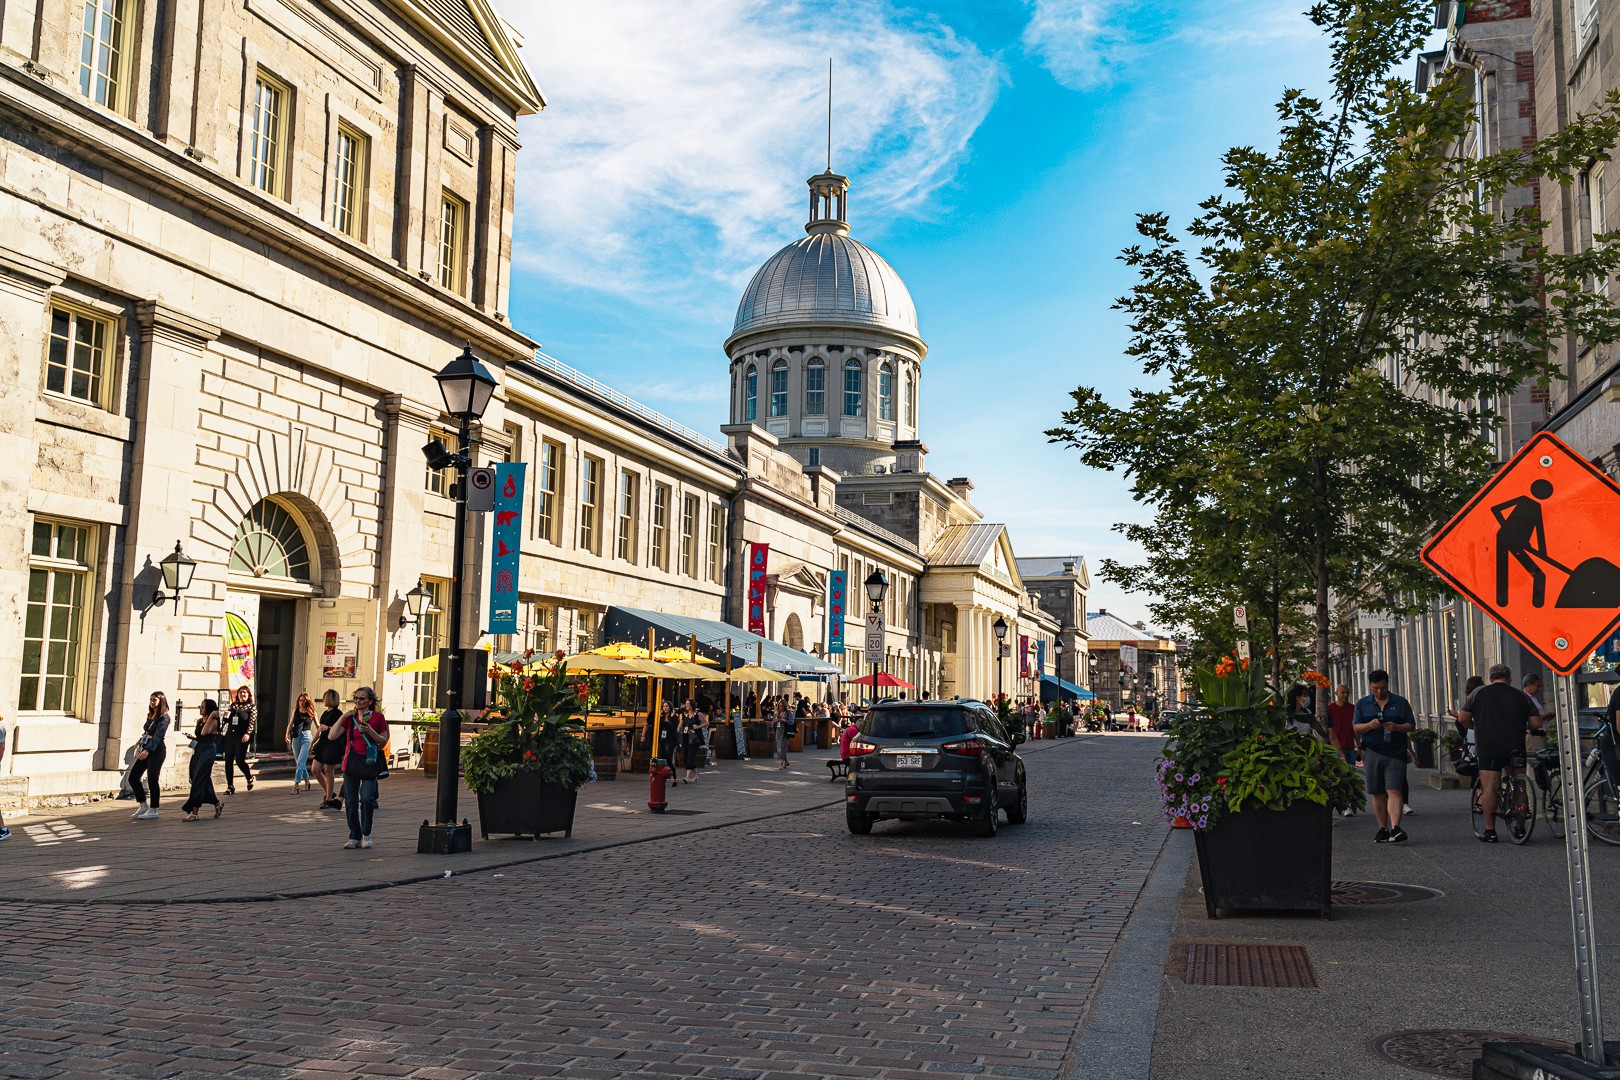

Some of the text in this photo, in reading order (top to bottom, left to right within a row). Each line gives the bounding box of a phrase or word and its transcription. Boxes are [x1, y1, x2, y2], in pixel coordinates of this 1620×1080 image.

[870, 639, 880, 649] 20
[1241, 641, 1246, 650] P
[911, 757, 922, 765] SRF
